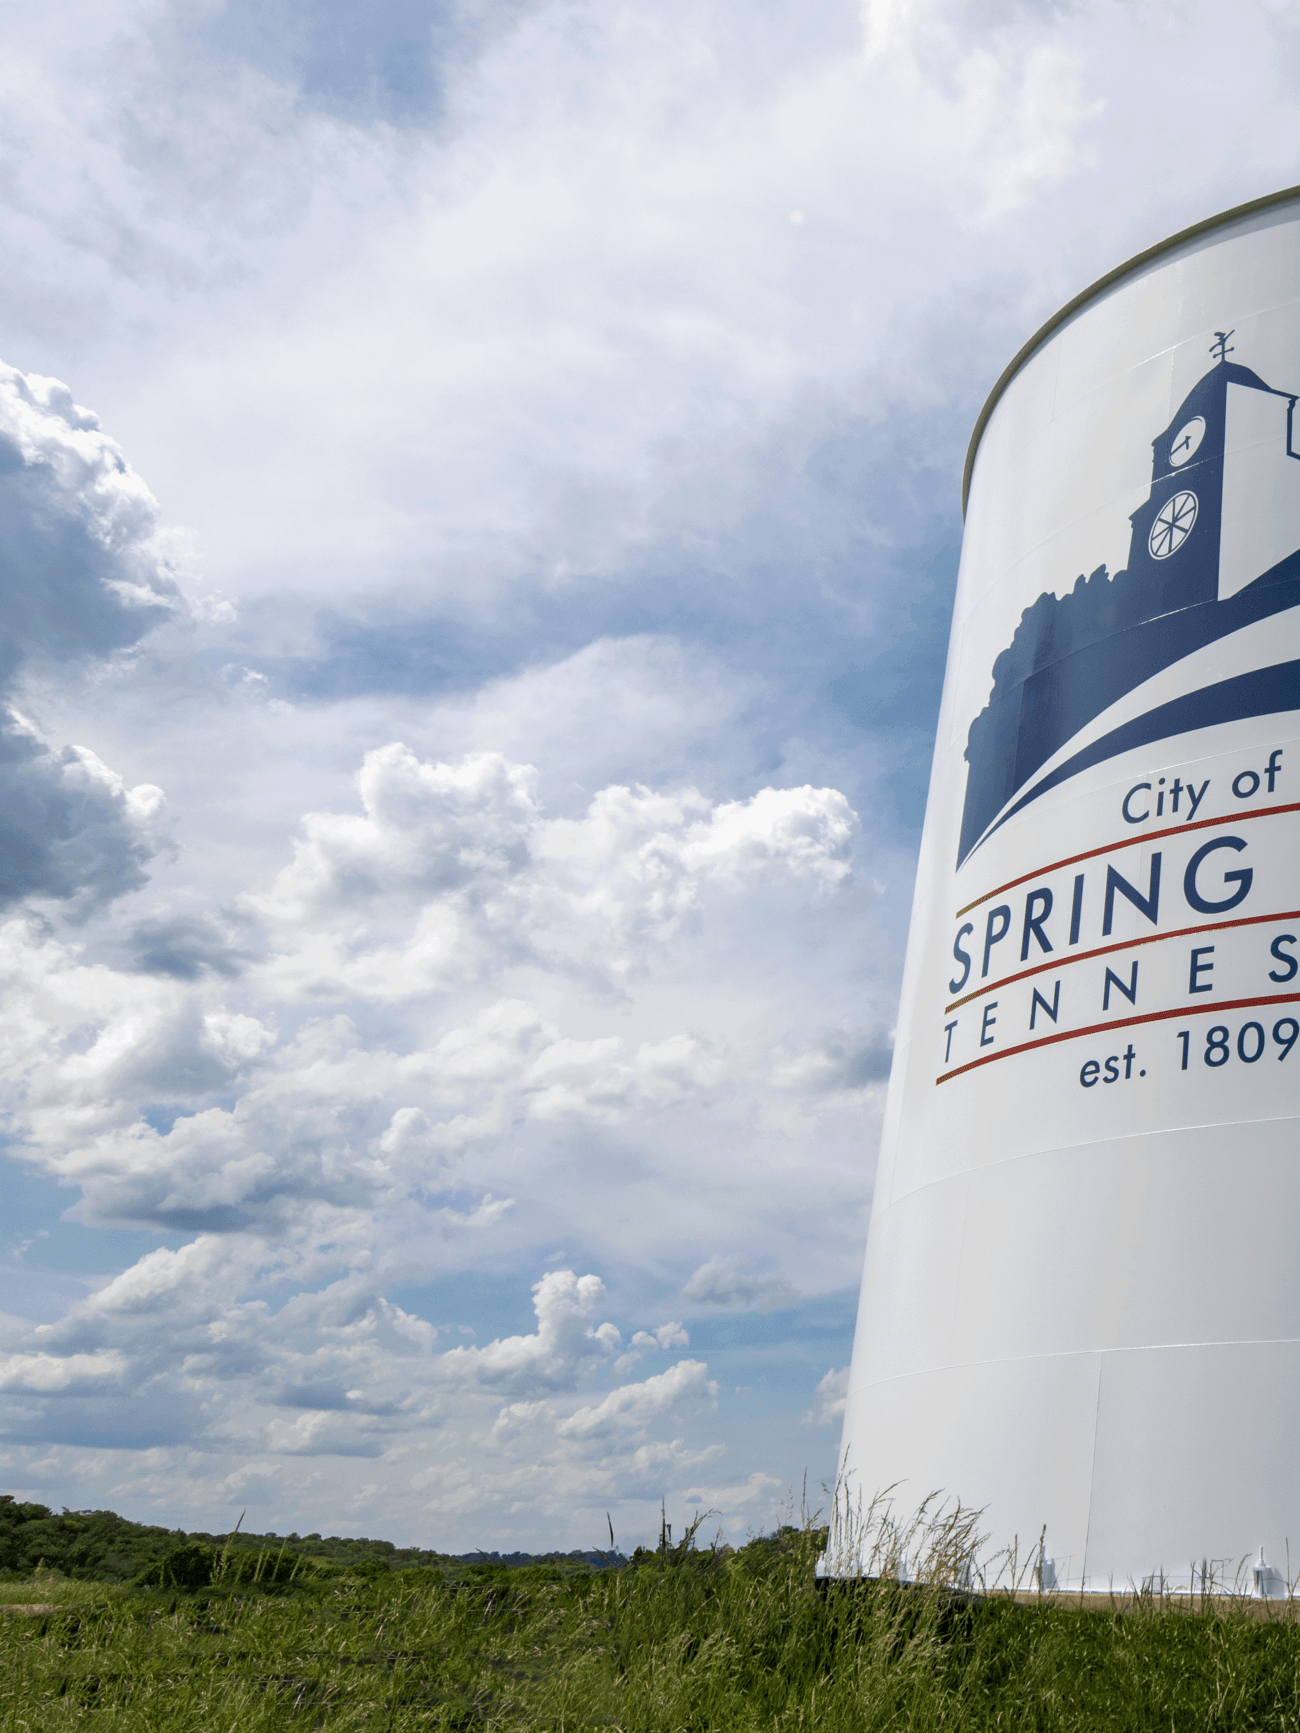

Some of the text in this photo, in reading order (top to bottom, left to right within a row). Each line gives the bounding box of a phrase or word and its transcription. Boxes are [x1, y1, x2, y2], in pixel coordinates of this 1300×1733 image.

[1122, 749, 1284, 824] City of
[948, 835, 1254, 994] SPRING
[1079, 1017, 1300, 1088] est. 1809
